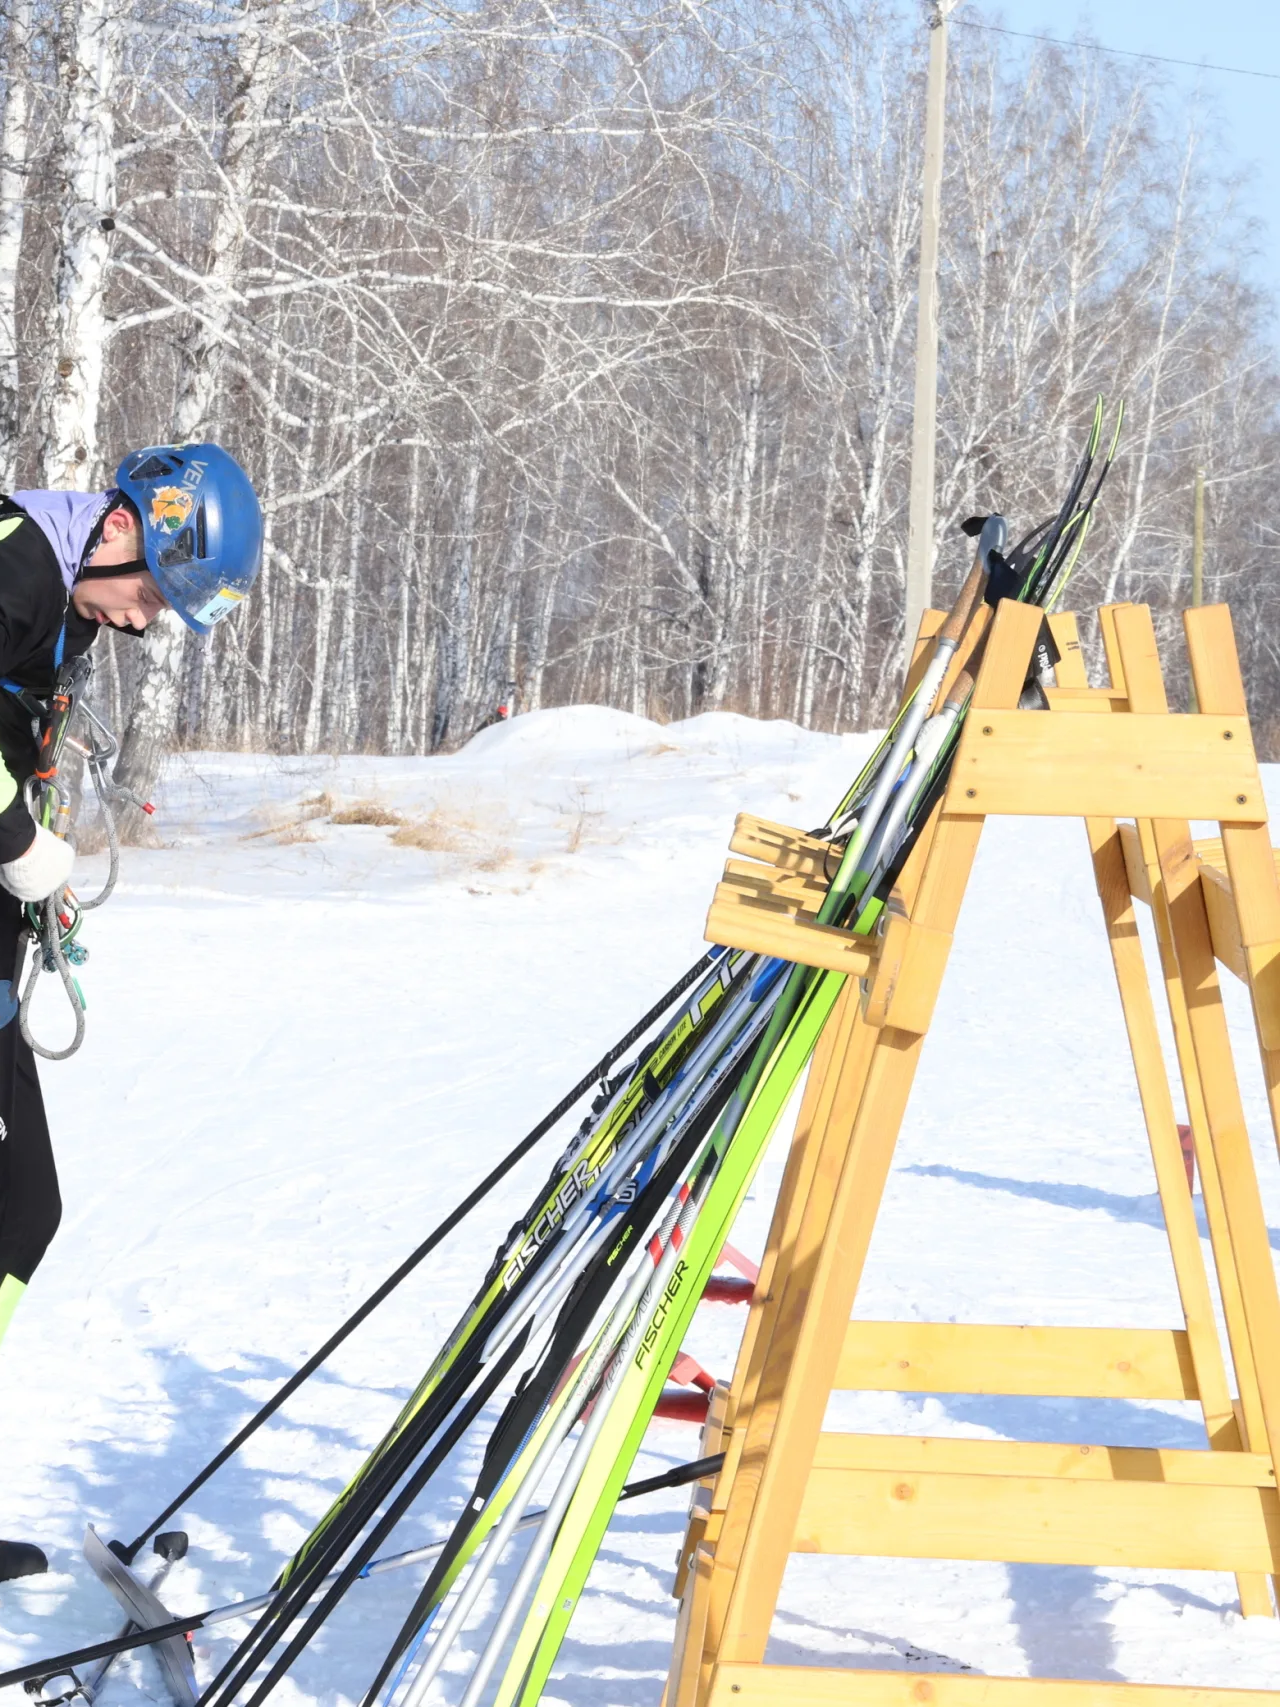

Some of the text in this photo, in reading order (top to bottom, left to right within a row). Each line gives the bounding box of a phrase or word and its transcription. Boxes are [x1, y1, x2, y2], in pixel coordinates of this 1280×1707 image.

[658, 1032, 677, 1060] CARBON
[676, 1019, 687, 1037] LITE
[502, 1158, 593, 1292] FISCHER
[607, 1223, 634, 1267] FISCHER
[634, 1259, 690, 1371] FISCHER
